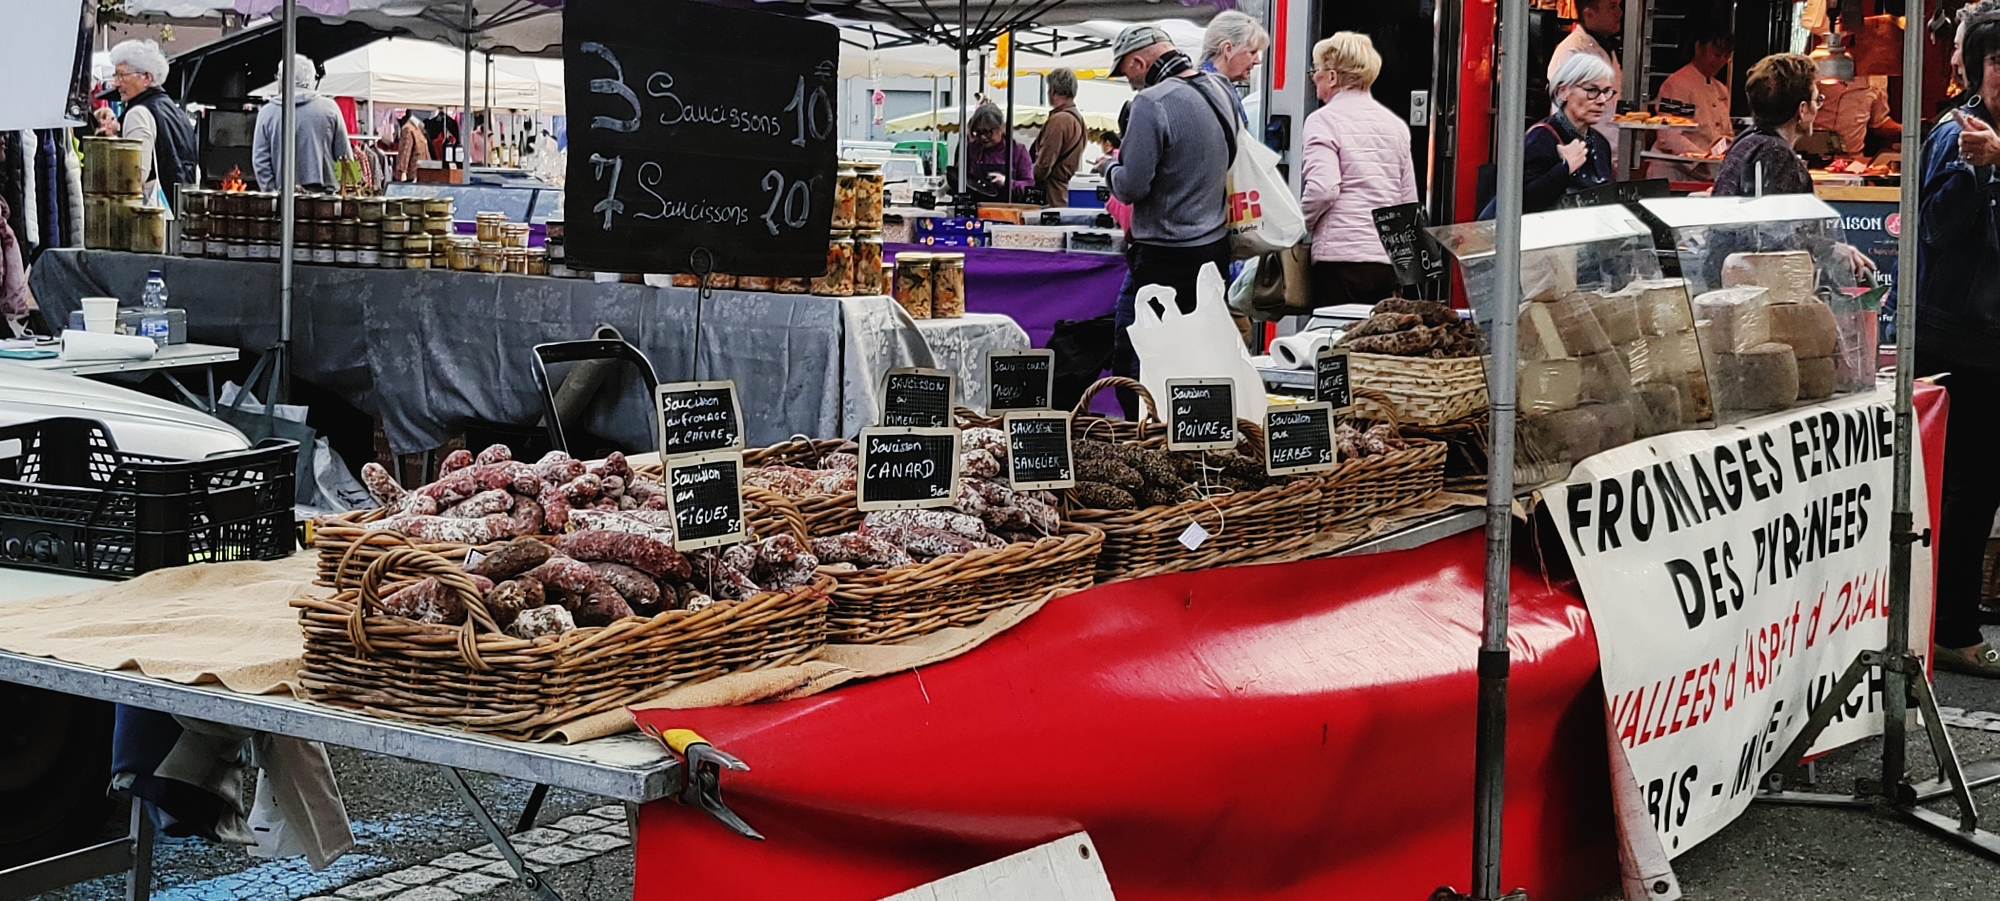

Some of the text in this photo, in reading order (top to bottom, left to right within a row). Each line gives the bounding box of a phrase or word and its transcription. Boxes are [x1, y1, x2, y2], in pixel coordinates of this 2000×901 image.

[580, 41, 642, 133] 3
[646, 71, 781, 136] Saucissons
[588, 152, 625, 232] 7
[633, 161, 749, 226] Saucissons
[1825, 216, 1883, 231] MAISON
[866, 458, 935, 480] CANARD
[1566, 405, 1894, 556] FROMAGES FERMIE
[1664, 541, 1744, 629] DES
